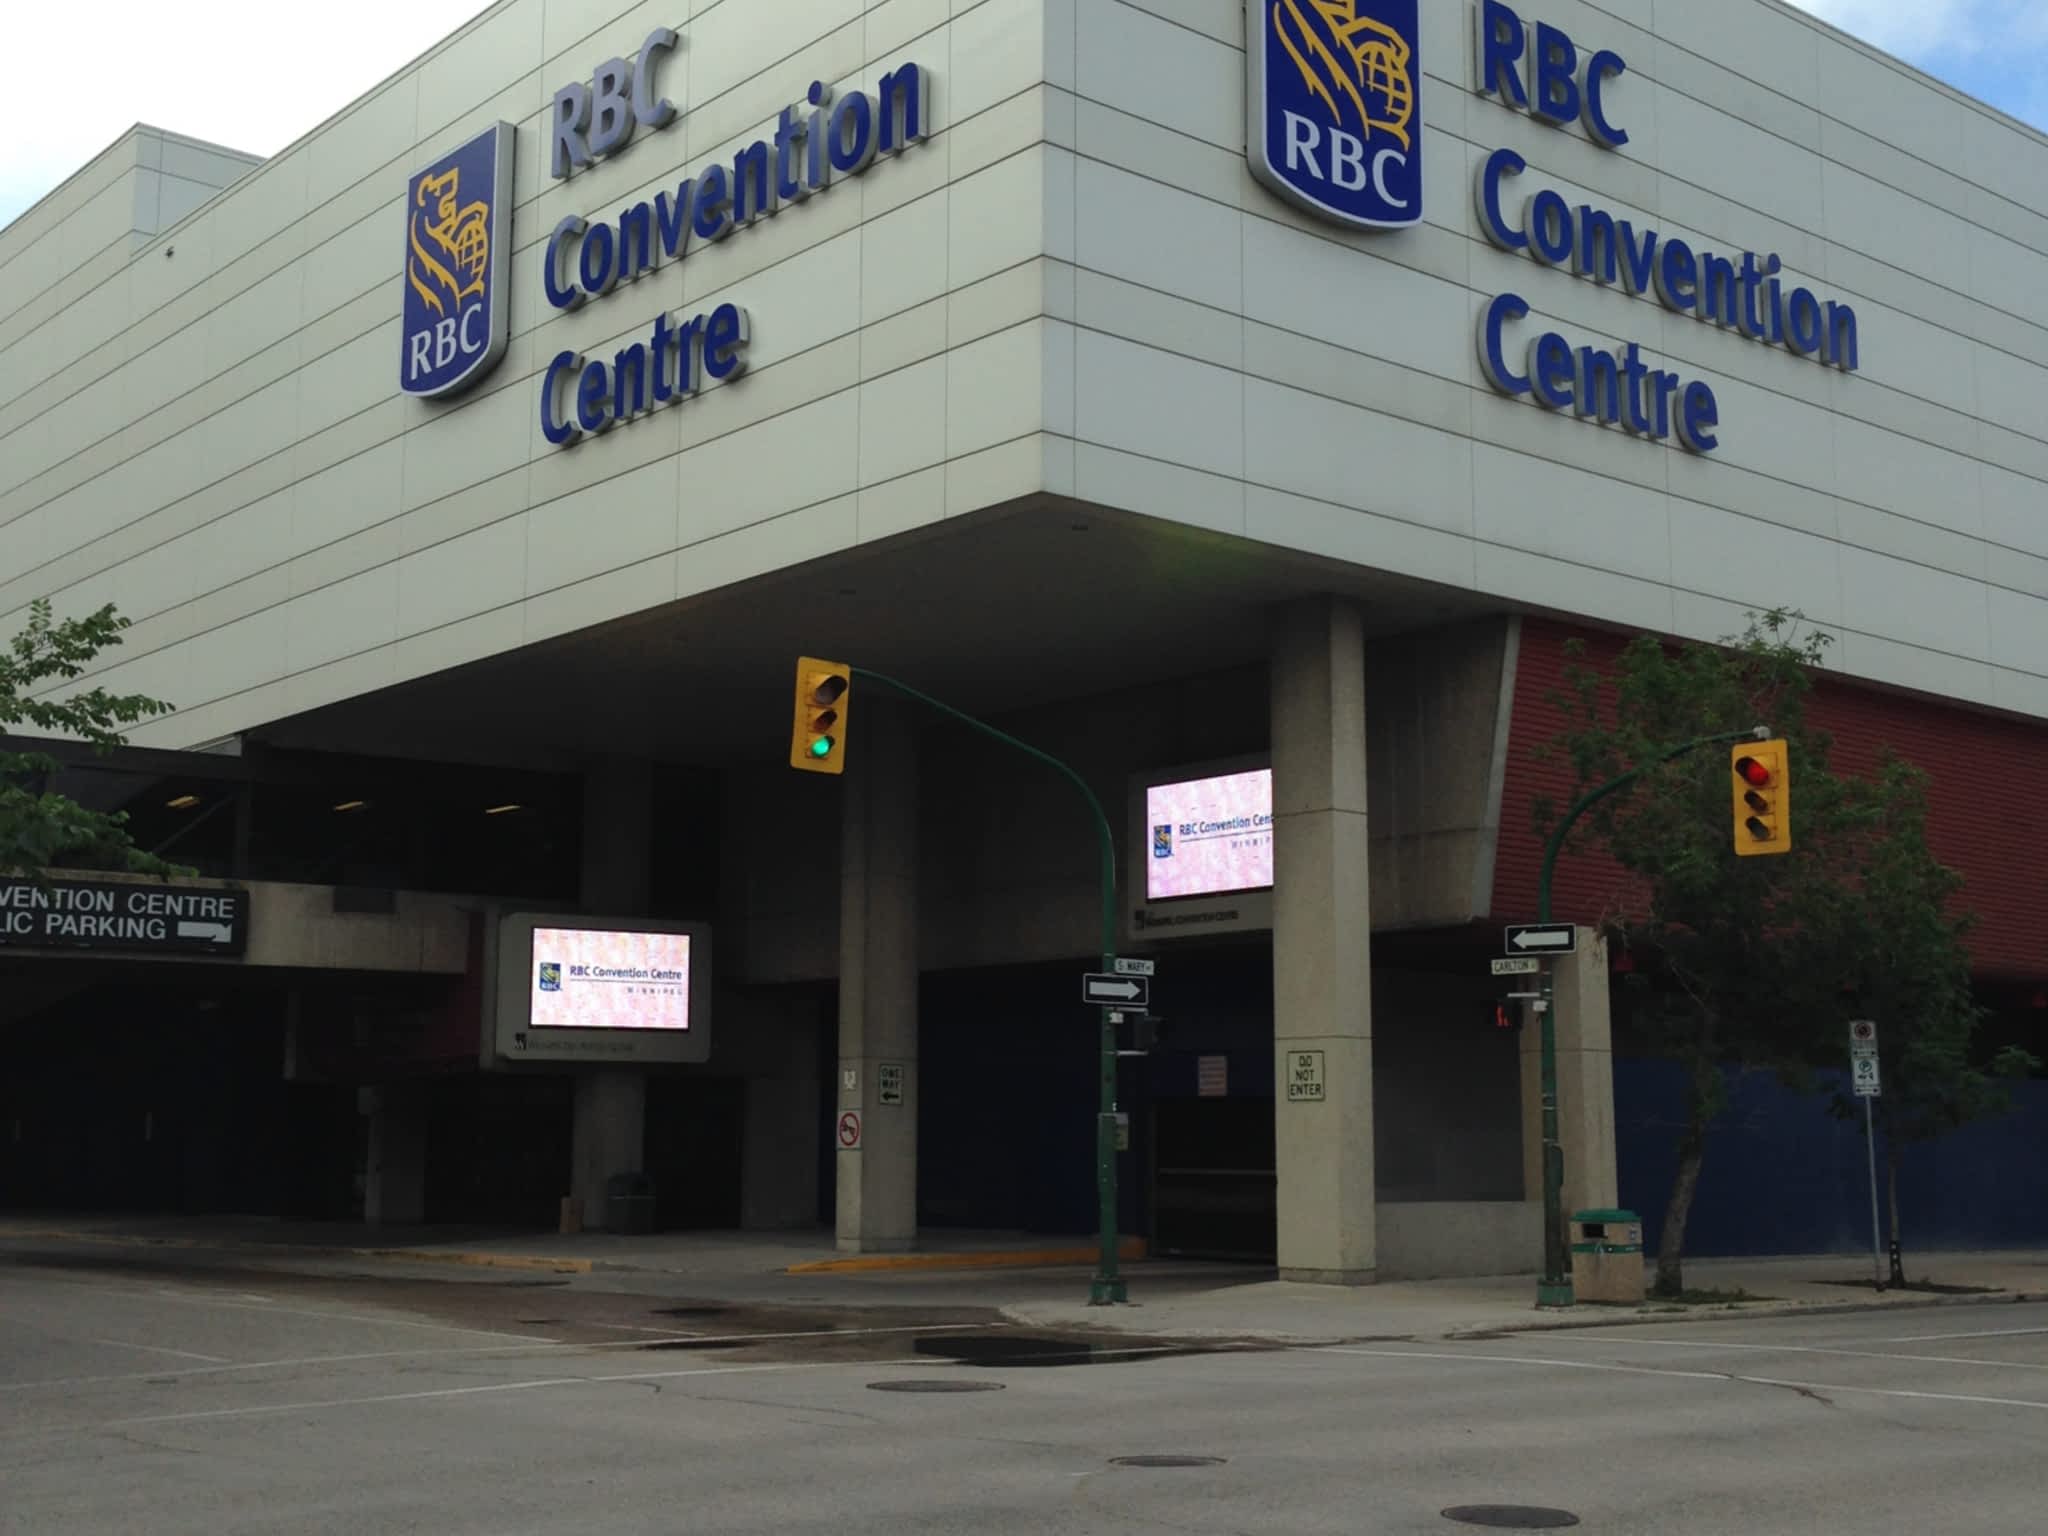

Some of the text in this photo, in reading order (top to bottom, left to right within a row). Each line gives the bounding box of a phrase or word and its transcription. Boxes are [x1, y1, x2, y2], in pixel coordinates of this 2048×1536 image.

[1475, 0, 1628, 148] RBC
[551, 27, 679, 179] RBC
[1282, 110, 1408, 208] RBC
[544, 62, 929, 310] Convention
[1476, 148, 1858, 371] Convention
[410, 303, 481, 381] RBC
[541, 303, 750, 445] Centre
[1477, 293, 1719, 453] Centre
[1179, 823, 1196, 836] RBC
[1199, 816, 1250, 833] Convention
[46, 914, 166, 939] PARKING
[127, 891, 236, 919] CENTRE
[570, 966, 682, 980] RBC Convention Centre
[881, 1066, 904, 1079] ONE
[1296, 1068, 1315, 1081] NOT
[1299, 1055, 1312, 1067] DO
[1290, 1083, 1321, 1096] ENTER
